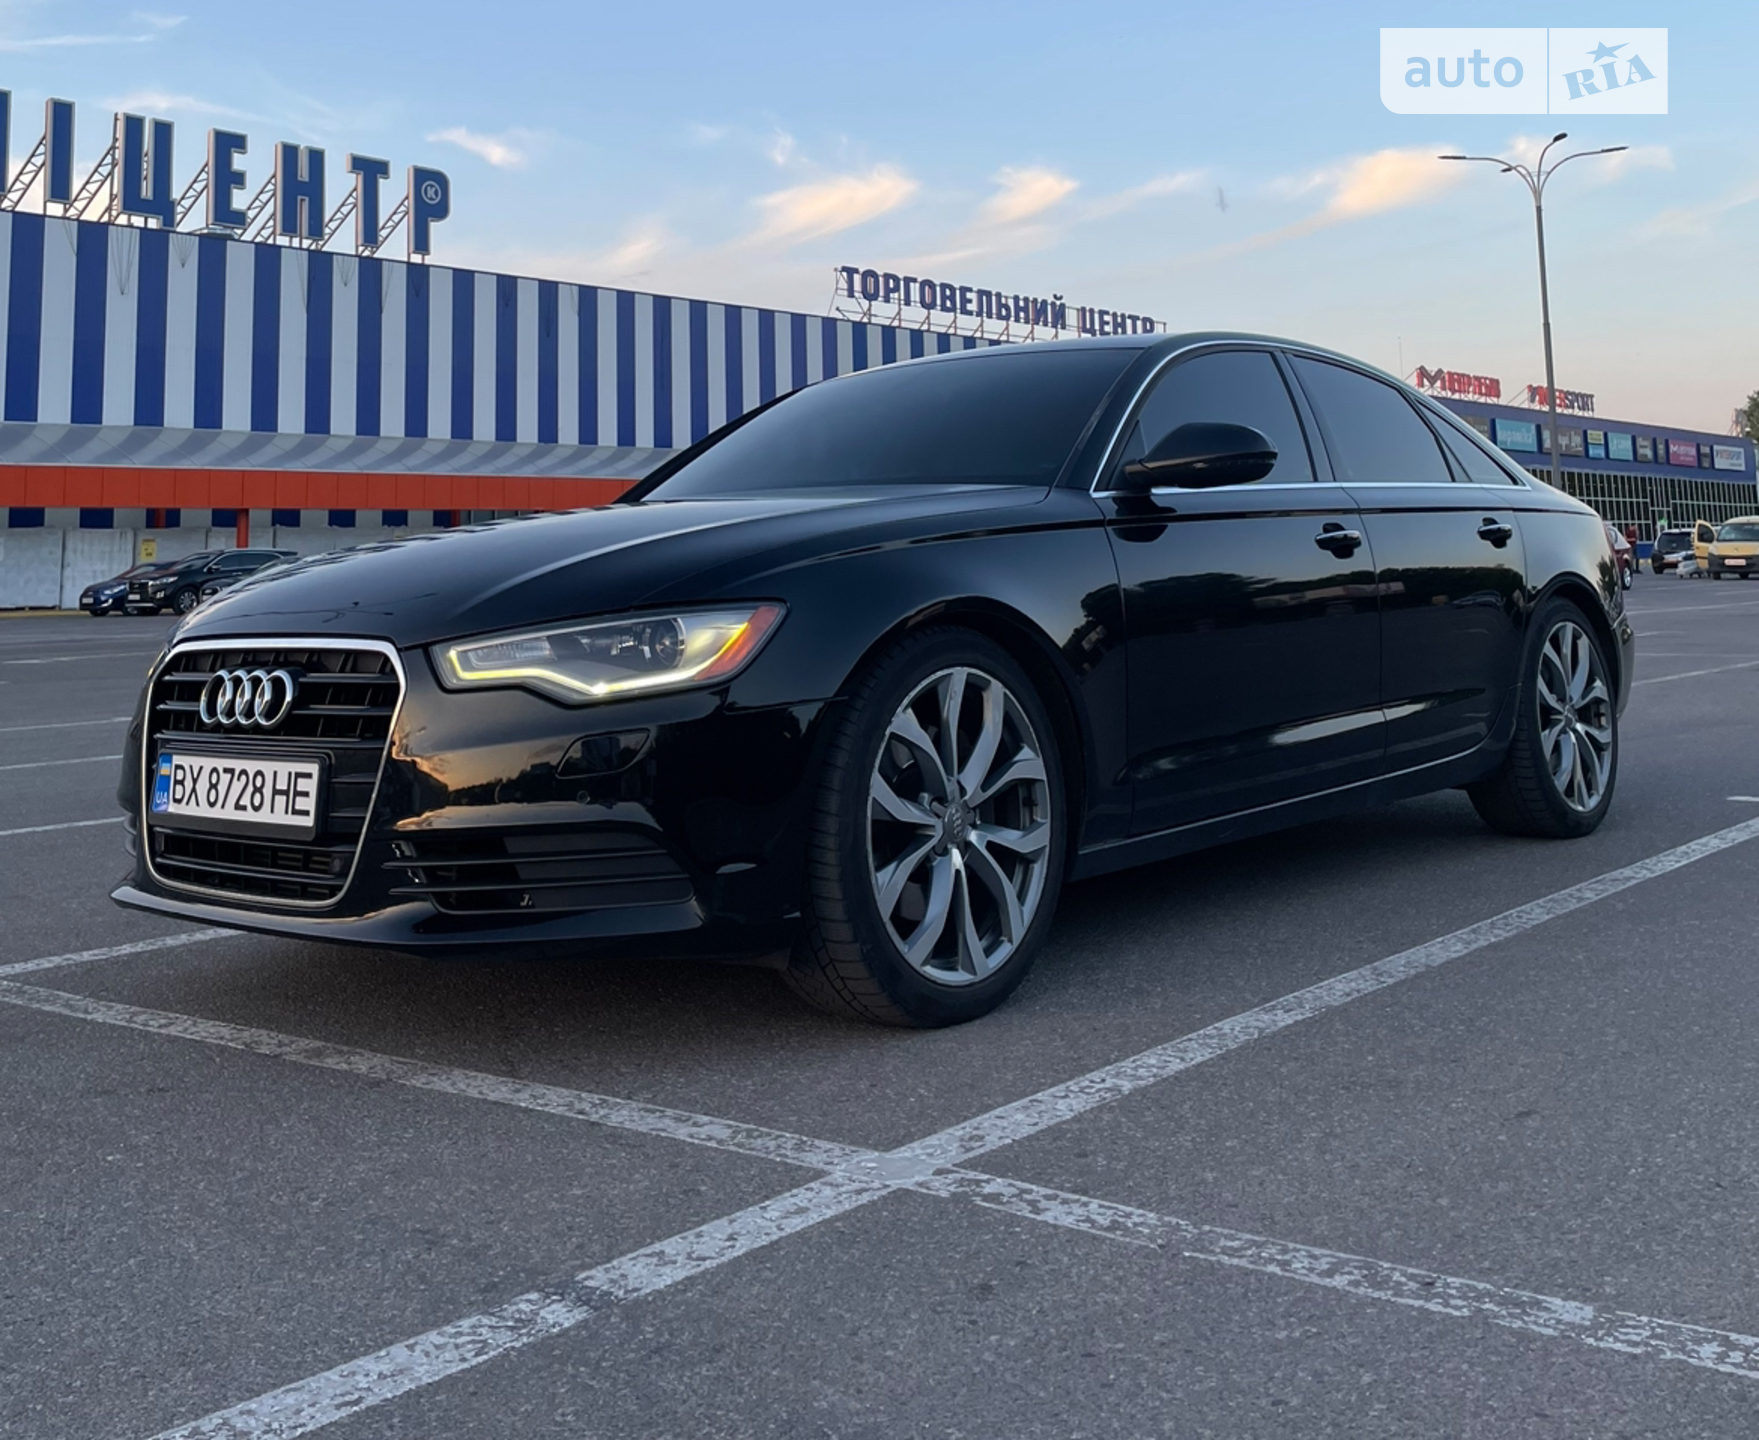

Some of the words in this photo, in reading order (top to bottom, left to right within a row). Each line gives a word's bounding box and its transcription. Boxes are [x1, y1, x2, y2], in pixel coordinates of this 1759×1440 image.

[841, 266, 1067, 329] ТОРГОВЕЛЬНИЙ
[1080, 306, 1156, 337] ЦЕНТР
[155, 791, 169, 804] UA
[206, 766, 266, 812] 8728
